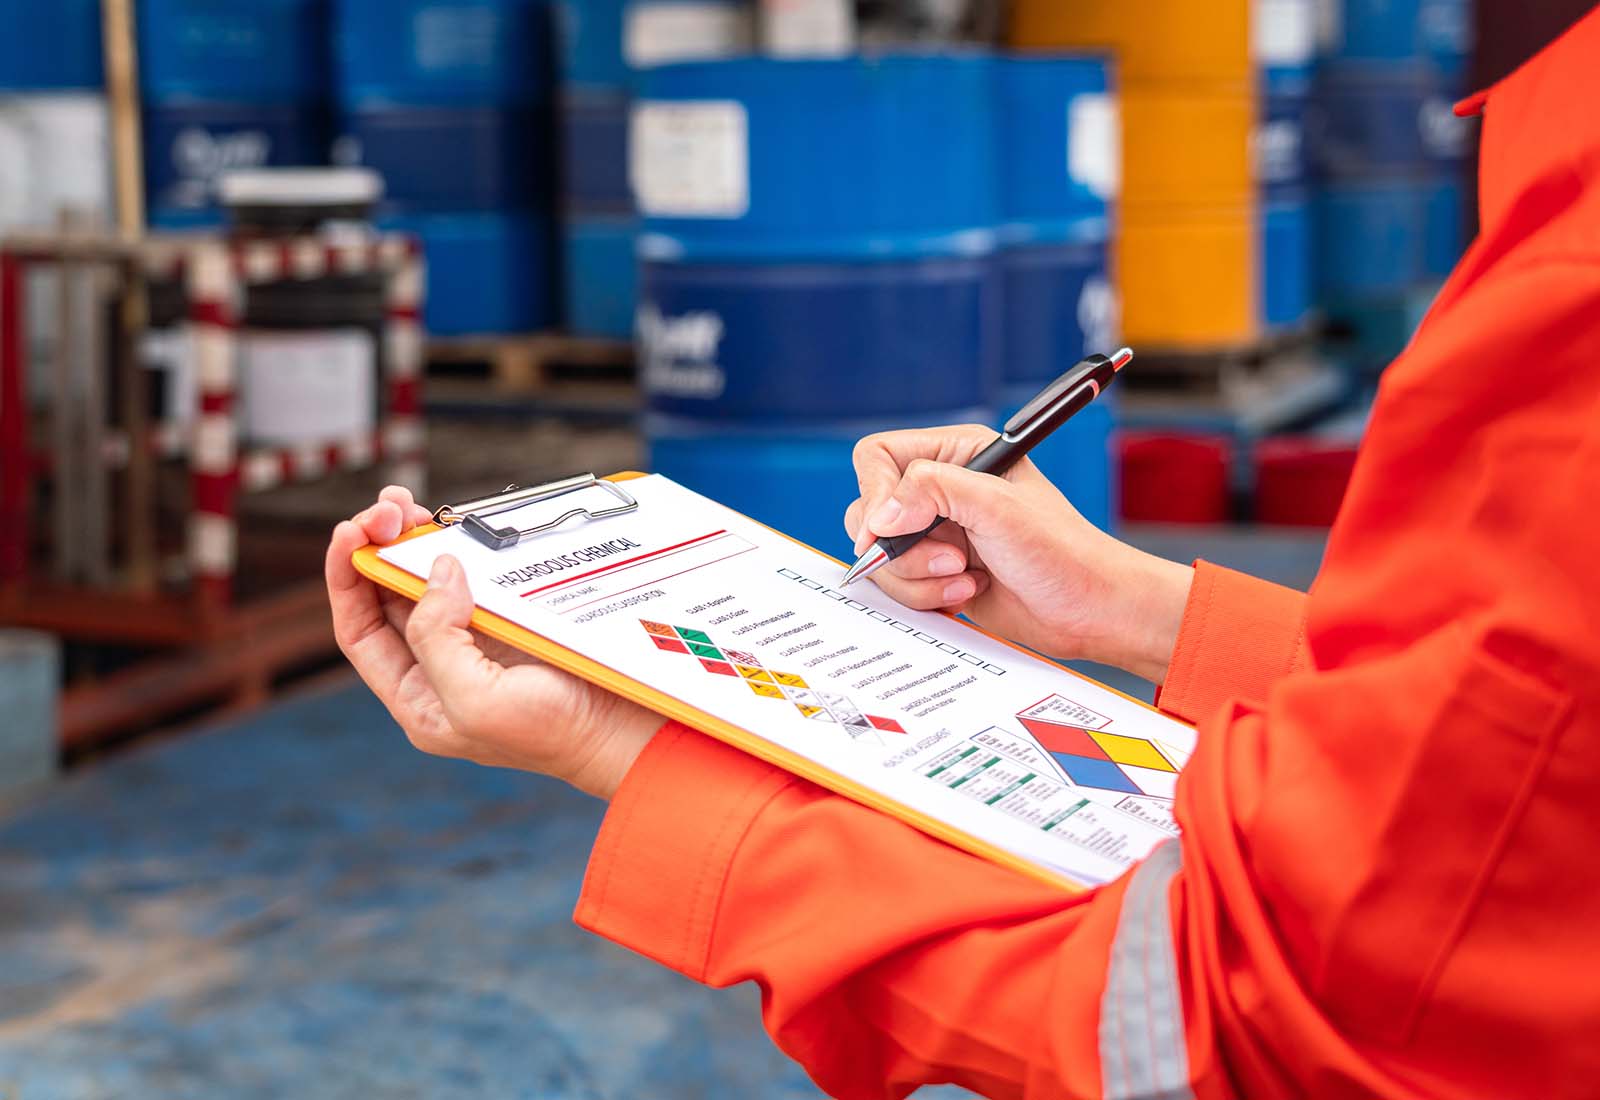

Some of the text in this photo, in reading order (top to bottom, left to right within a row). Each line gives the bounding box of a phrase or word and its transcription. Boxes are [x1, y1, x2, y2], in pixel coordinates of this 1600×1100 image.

[490, 537, 641, 588] HAZARDOUS CHEMICAL
[574, 603, 617, 623] HAZARDOUS
[685, 605, 703, 614] CLASS
[708, 616, 726, 625] CLASS
[732, 626, 750, 635] CLASS
[755, 637, 774, 646] CLASS
